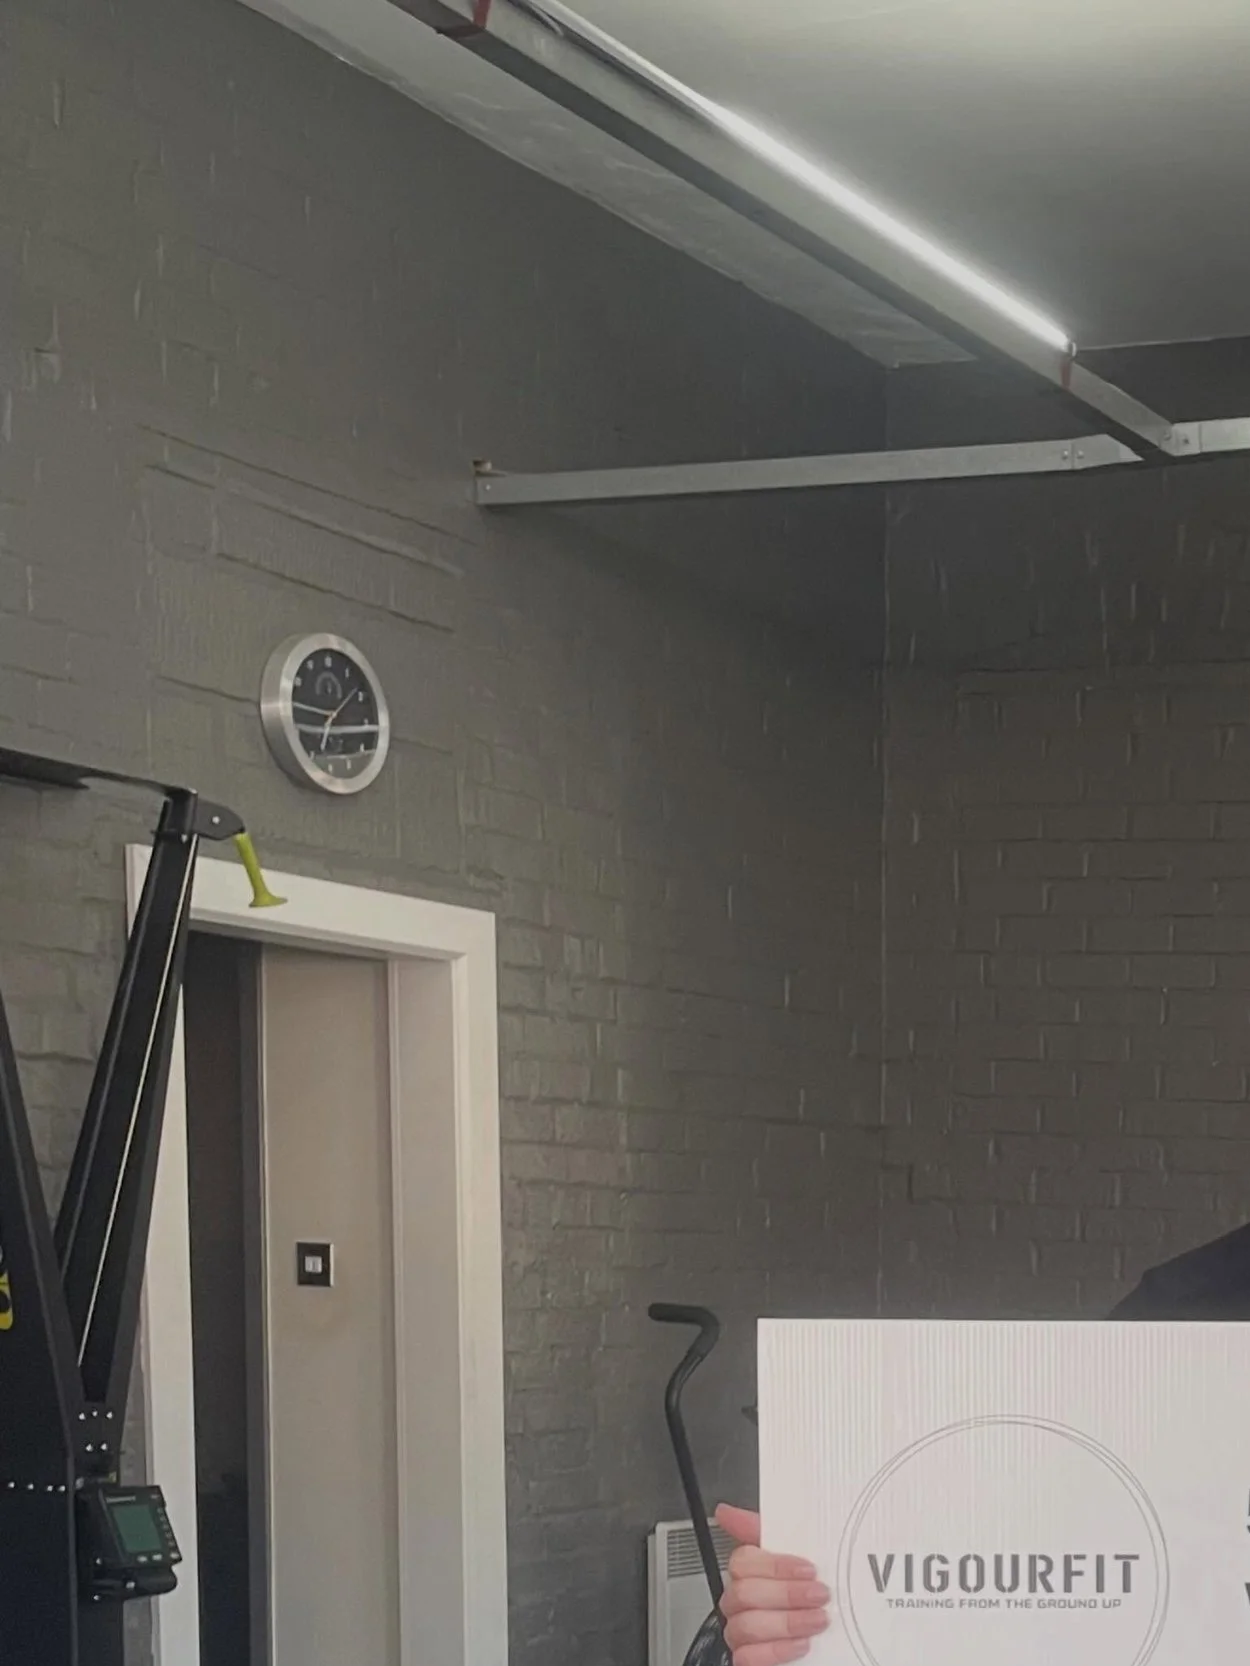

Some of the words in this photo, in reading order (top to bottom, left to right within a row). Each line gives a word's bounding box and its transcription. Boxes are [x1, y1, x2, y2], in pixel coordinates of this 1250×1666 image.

[867, 1553, 1140, 1594] VIGOURFIT
[886, 1598, 954, 1609] TRAINING
[958, 1598, 1001, 1609] FROM
[1005, 1598, 1032, 1609] THE
[1036, 1598, 1098, 1609] GROUND
[1101, 1598, 1122, 1609] UP
